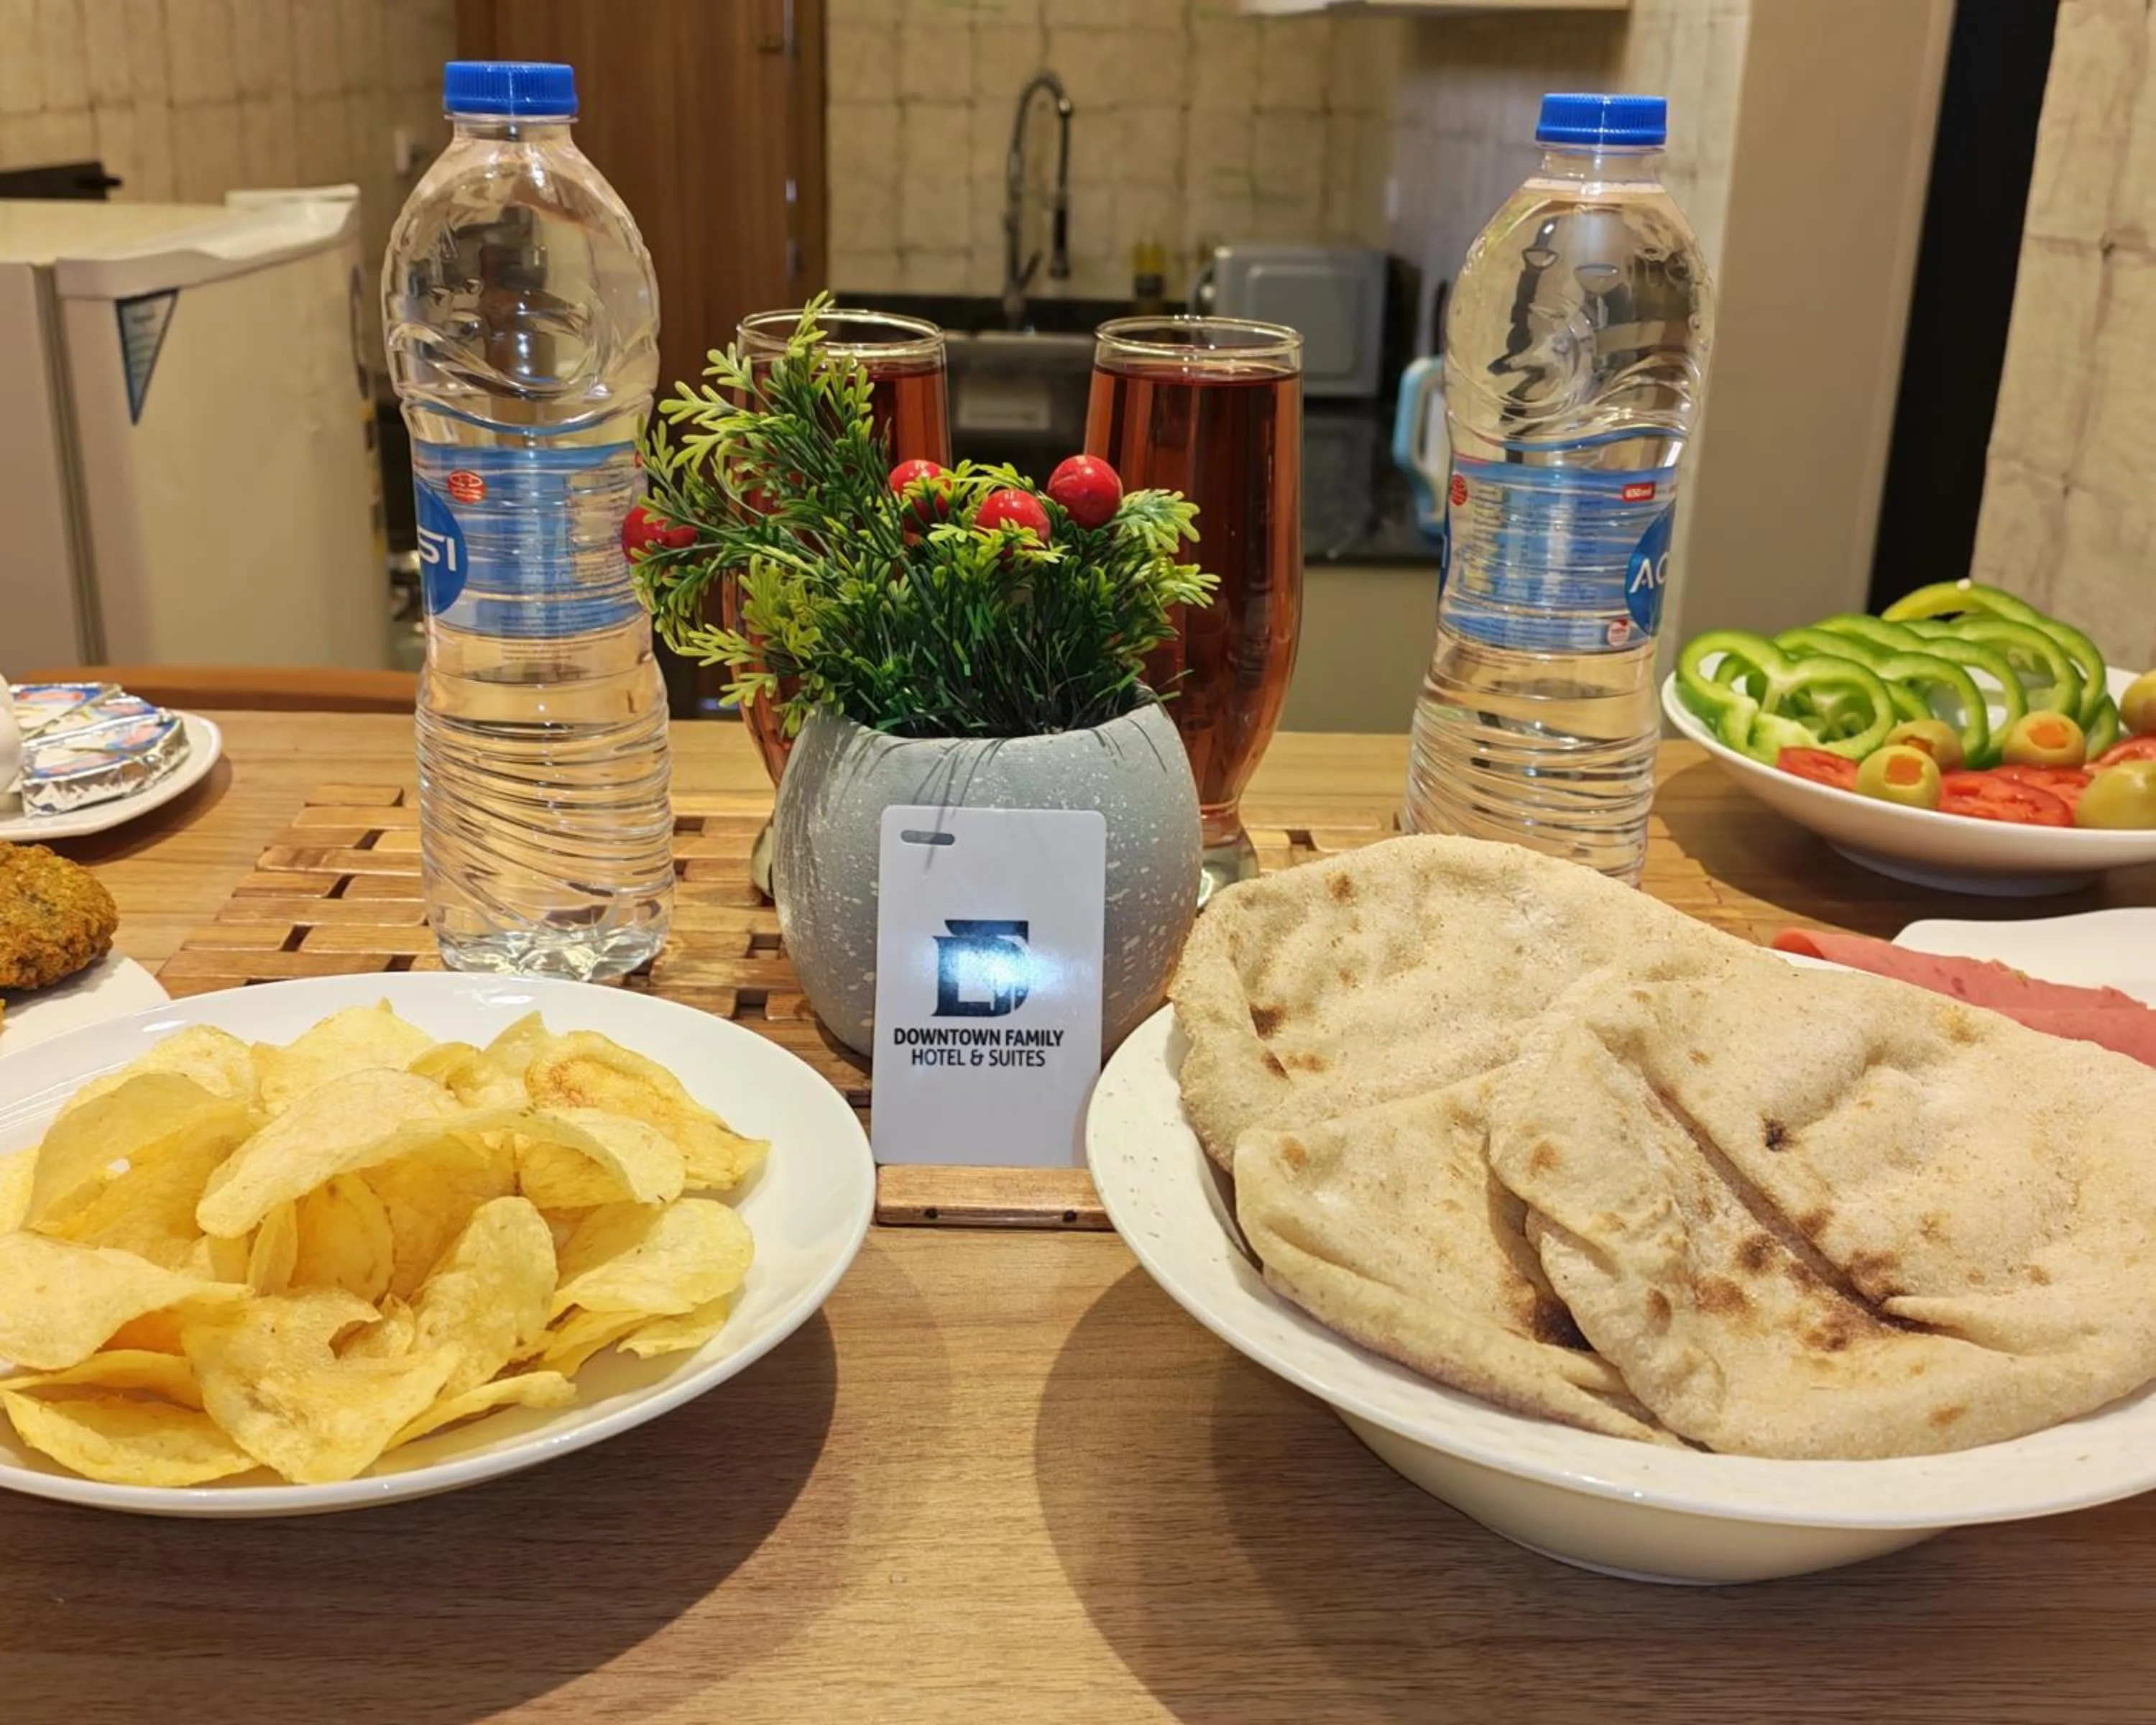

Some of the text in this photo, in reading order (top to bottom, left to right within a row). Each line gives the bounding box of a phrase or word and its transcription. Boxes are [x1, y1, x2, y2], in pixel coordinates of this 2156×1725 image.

[893, 1028, 1064, 1046] DOWNTOWN FAMILY
[911, 1048, 1046, 1067] HOTEL & SUITES
